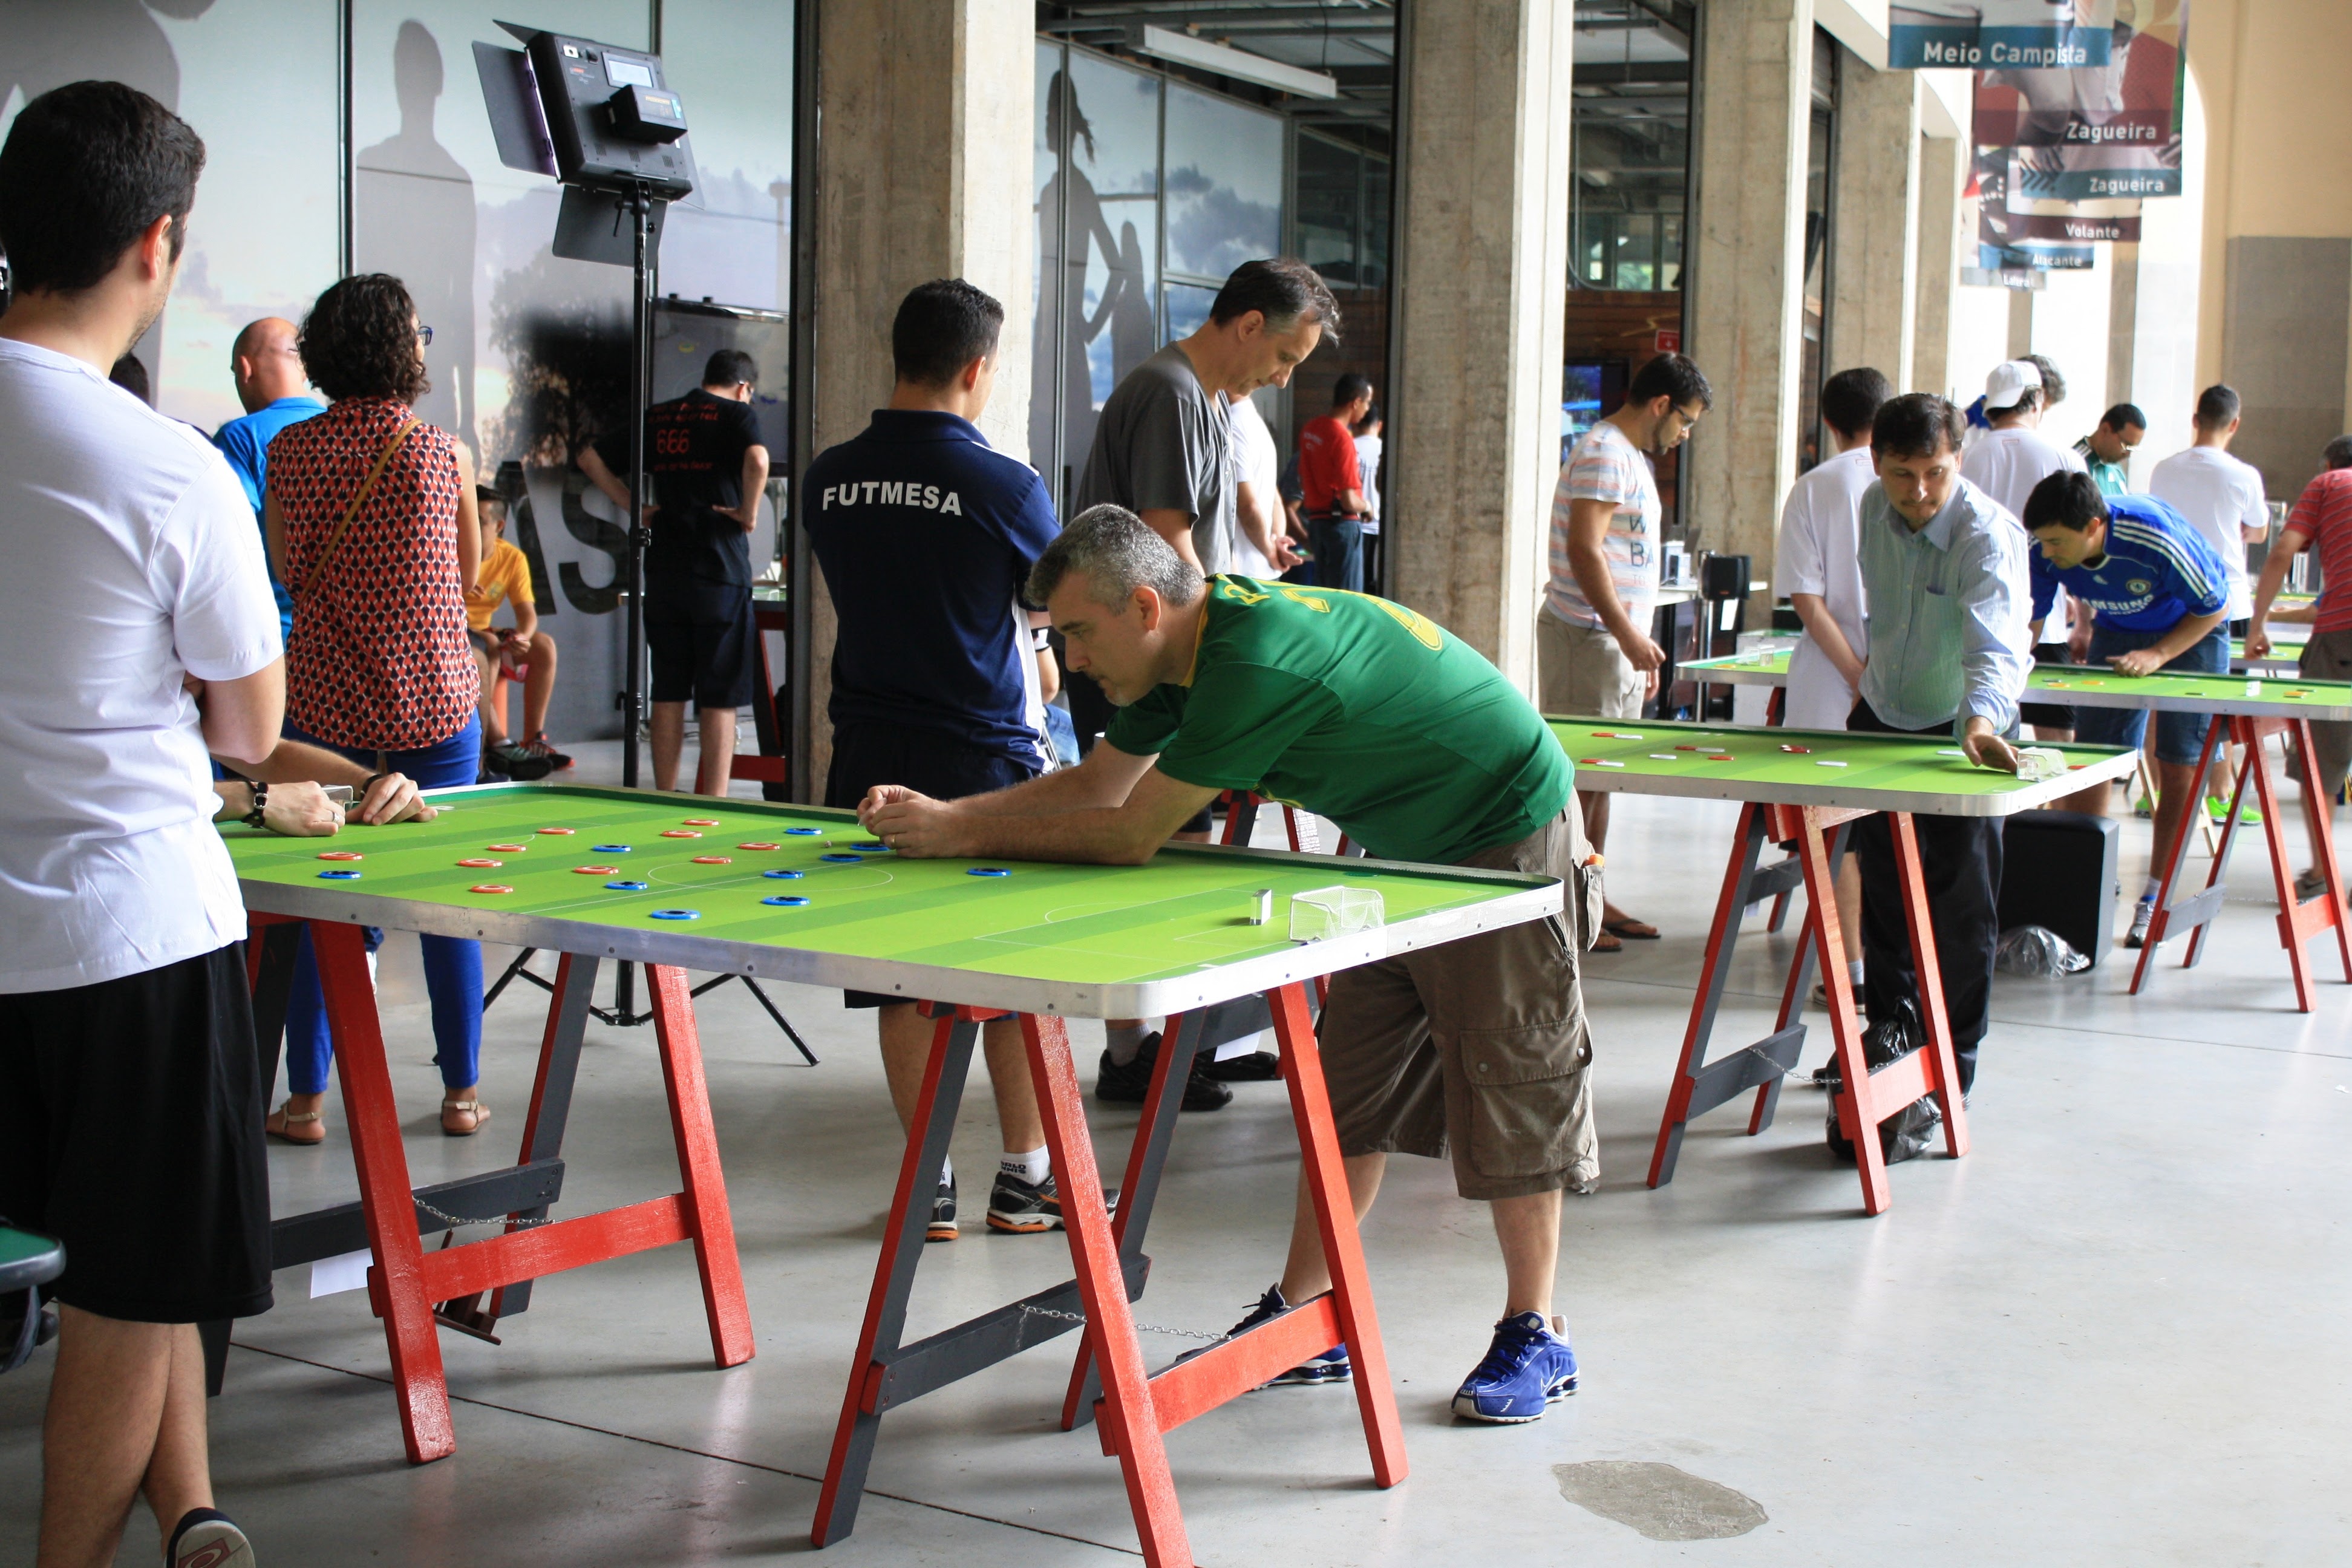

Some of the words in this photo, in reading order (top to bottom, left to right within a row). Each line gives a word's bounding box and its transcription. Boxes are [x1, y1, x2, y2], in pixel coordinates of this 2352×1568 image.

[1923, 42, 1982, 63] Meio
[1990, 42, 2086, 68] Campista
[2066, 121, 2157, 143] Zagueira
[2089, 177, 2165, 195] Zagueira
[2065, 223, 2120, 239] Volante
[657, 430, 690, 453] 666
[822, 482, 962, 516] FUTMESA
